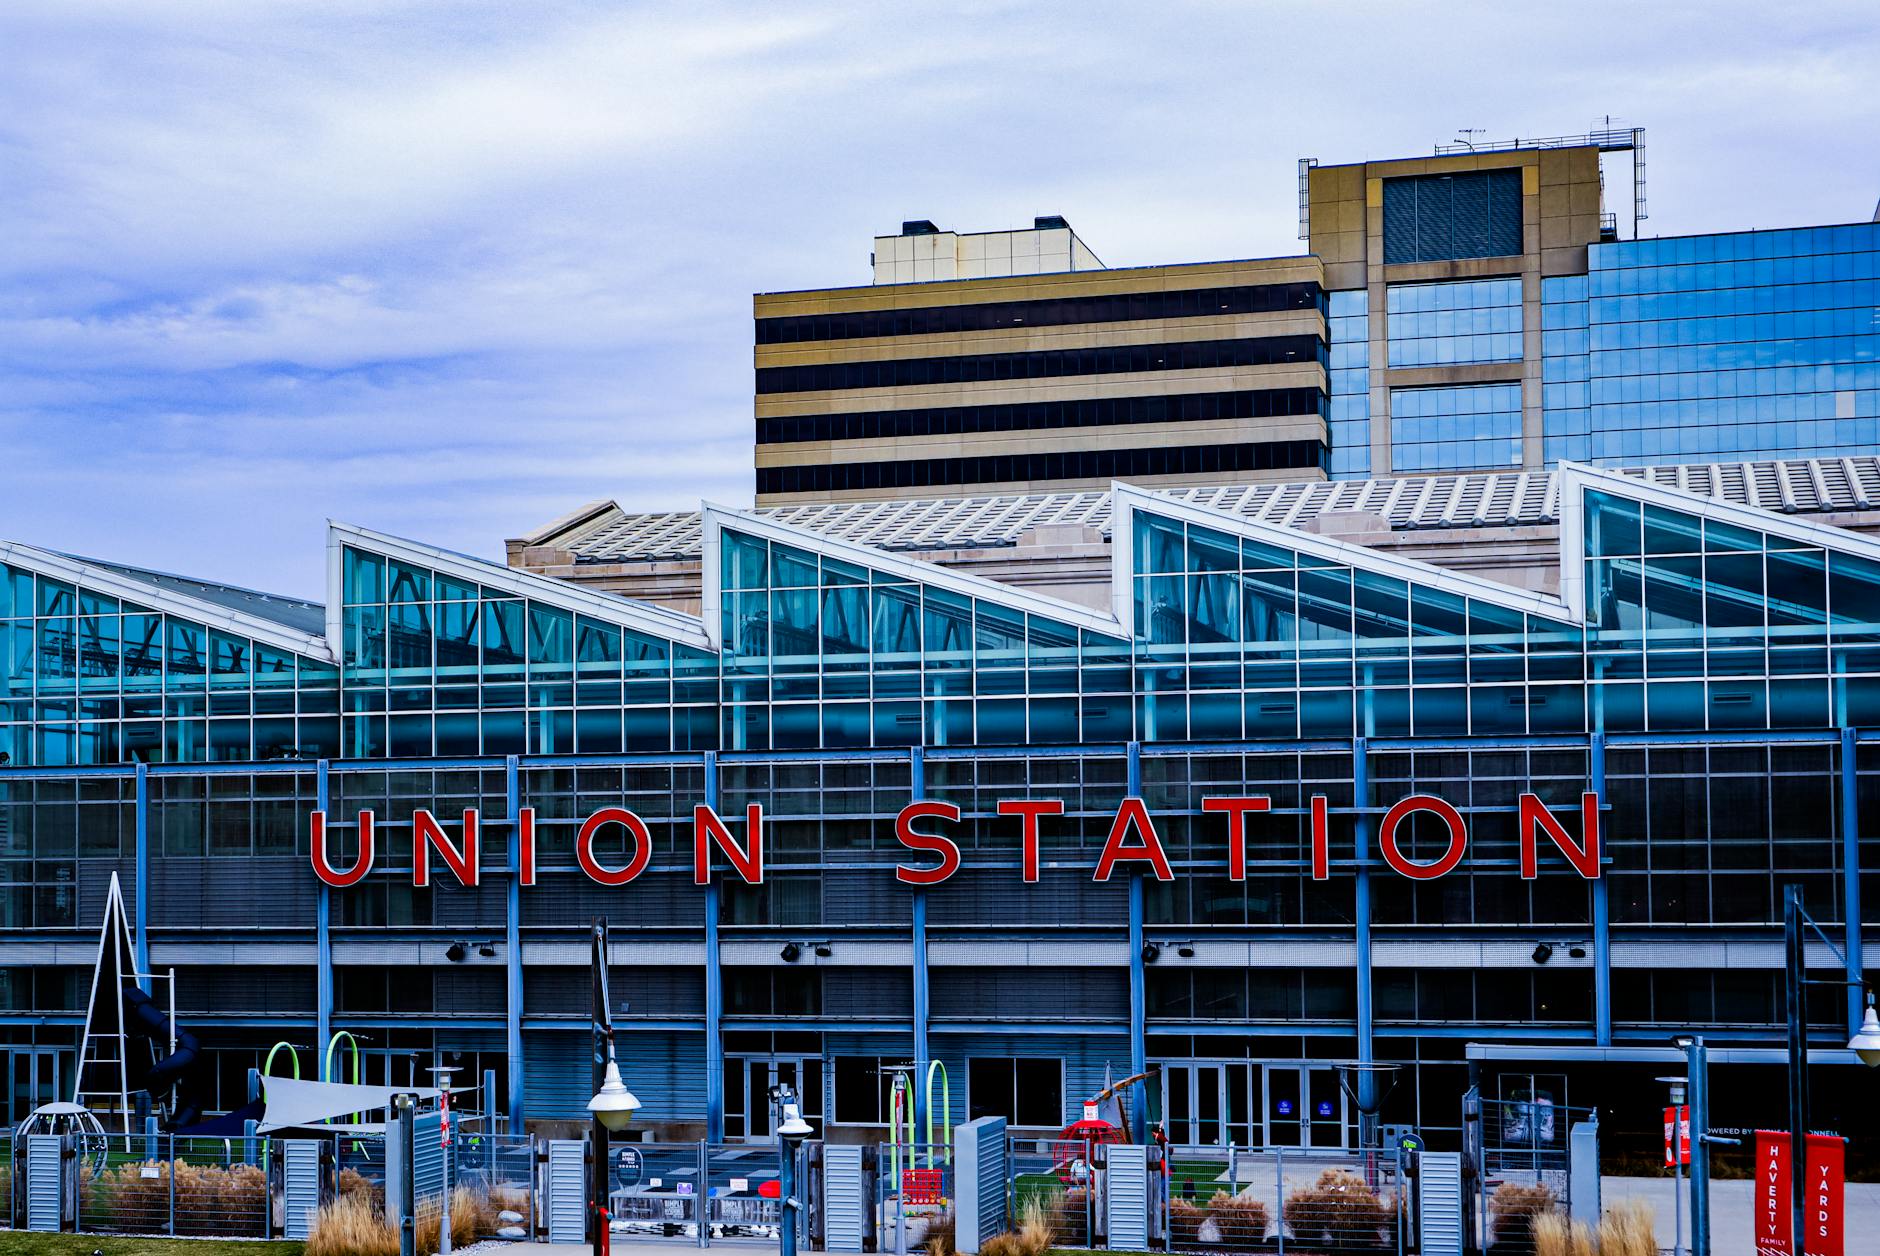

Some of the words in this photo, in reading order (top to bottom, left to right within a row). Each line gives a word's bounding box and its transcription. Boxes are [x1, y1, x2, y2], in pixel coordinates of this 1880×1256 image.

[310, 802, 764, 888] UNION
[895, 790, 1601, 886] STATION
[1768, 1145, 1779, 1235] HAVERTY
[1818, 1166, 1829, 1237] YARDS
[1760, 1237, 1786, 1246] FAMILY
